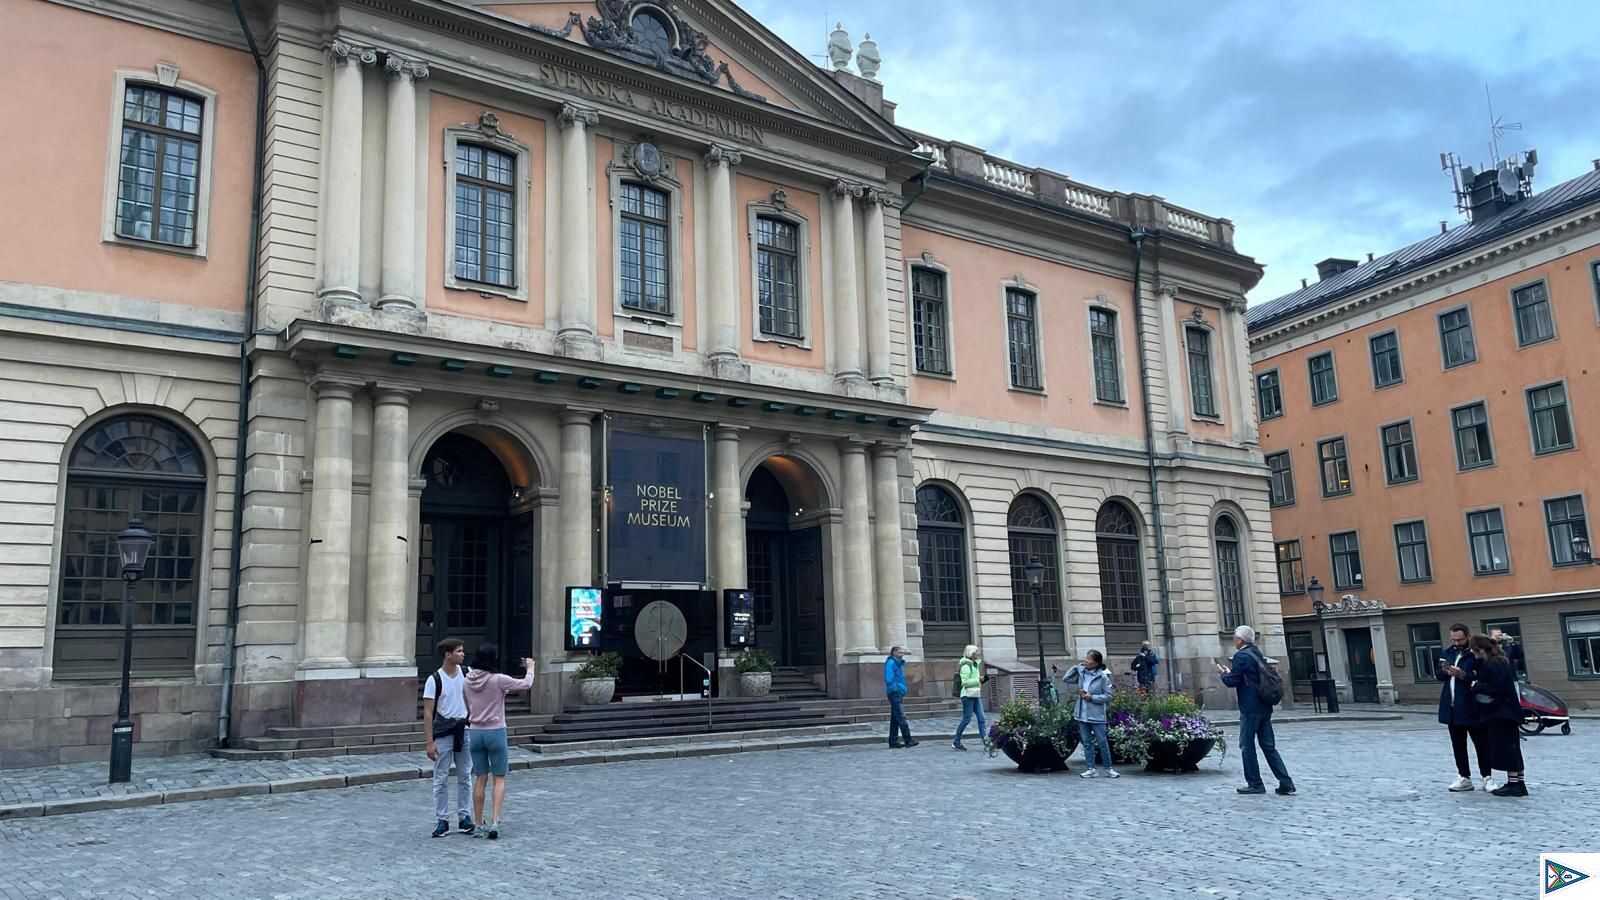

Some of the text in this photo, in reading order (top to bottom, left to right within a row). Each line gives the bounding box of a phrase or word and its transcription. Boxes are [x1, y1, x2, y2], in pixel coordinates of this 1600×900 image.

[540, 63, 765, 144] SVENSKA AKADEMIEN
[636, 484, 682, 500] NOBEL
[641, 499, 678, 513] PRIZE
[627, 512, 690, 528] MUSEUM
